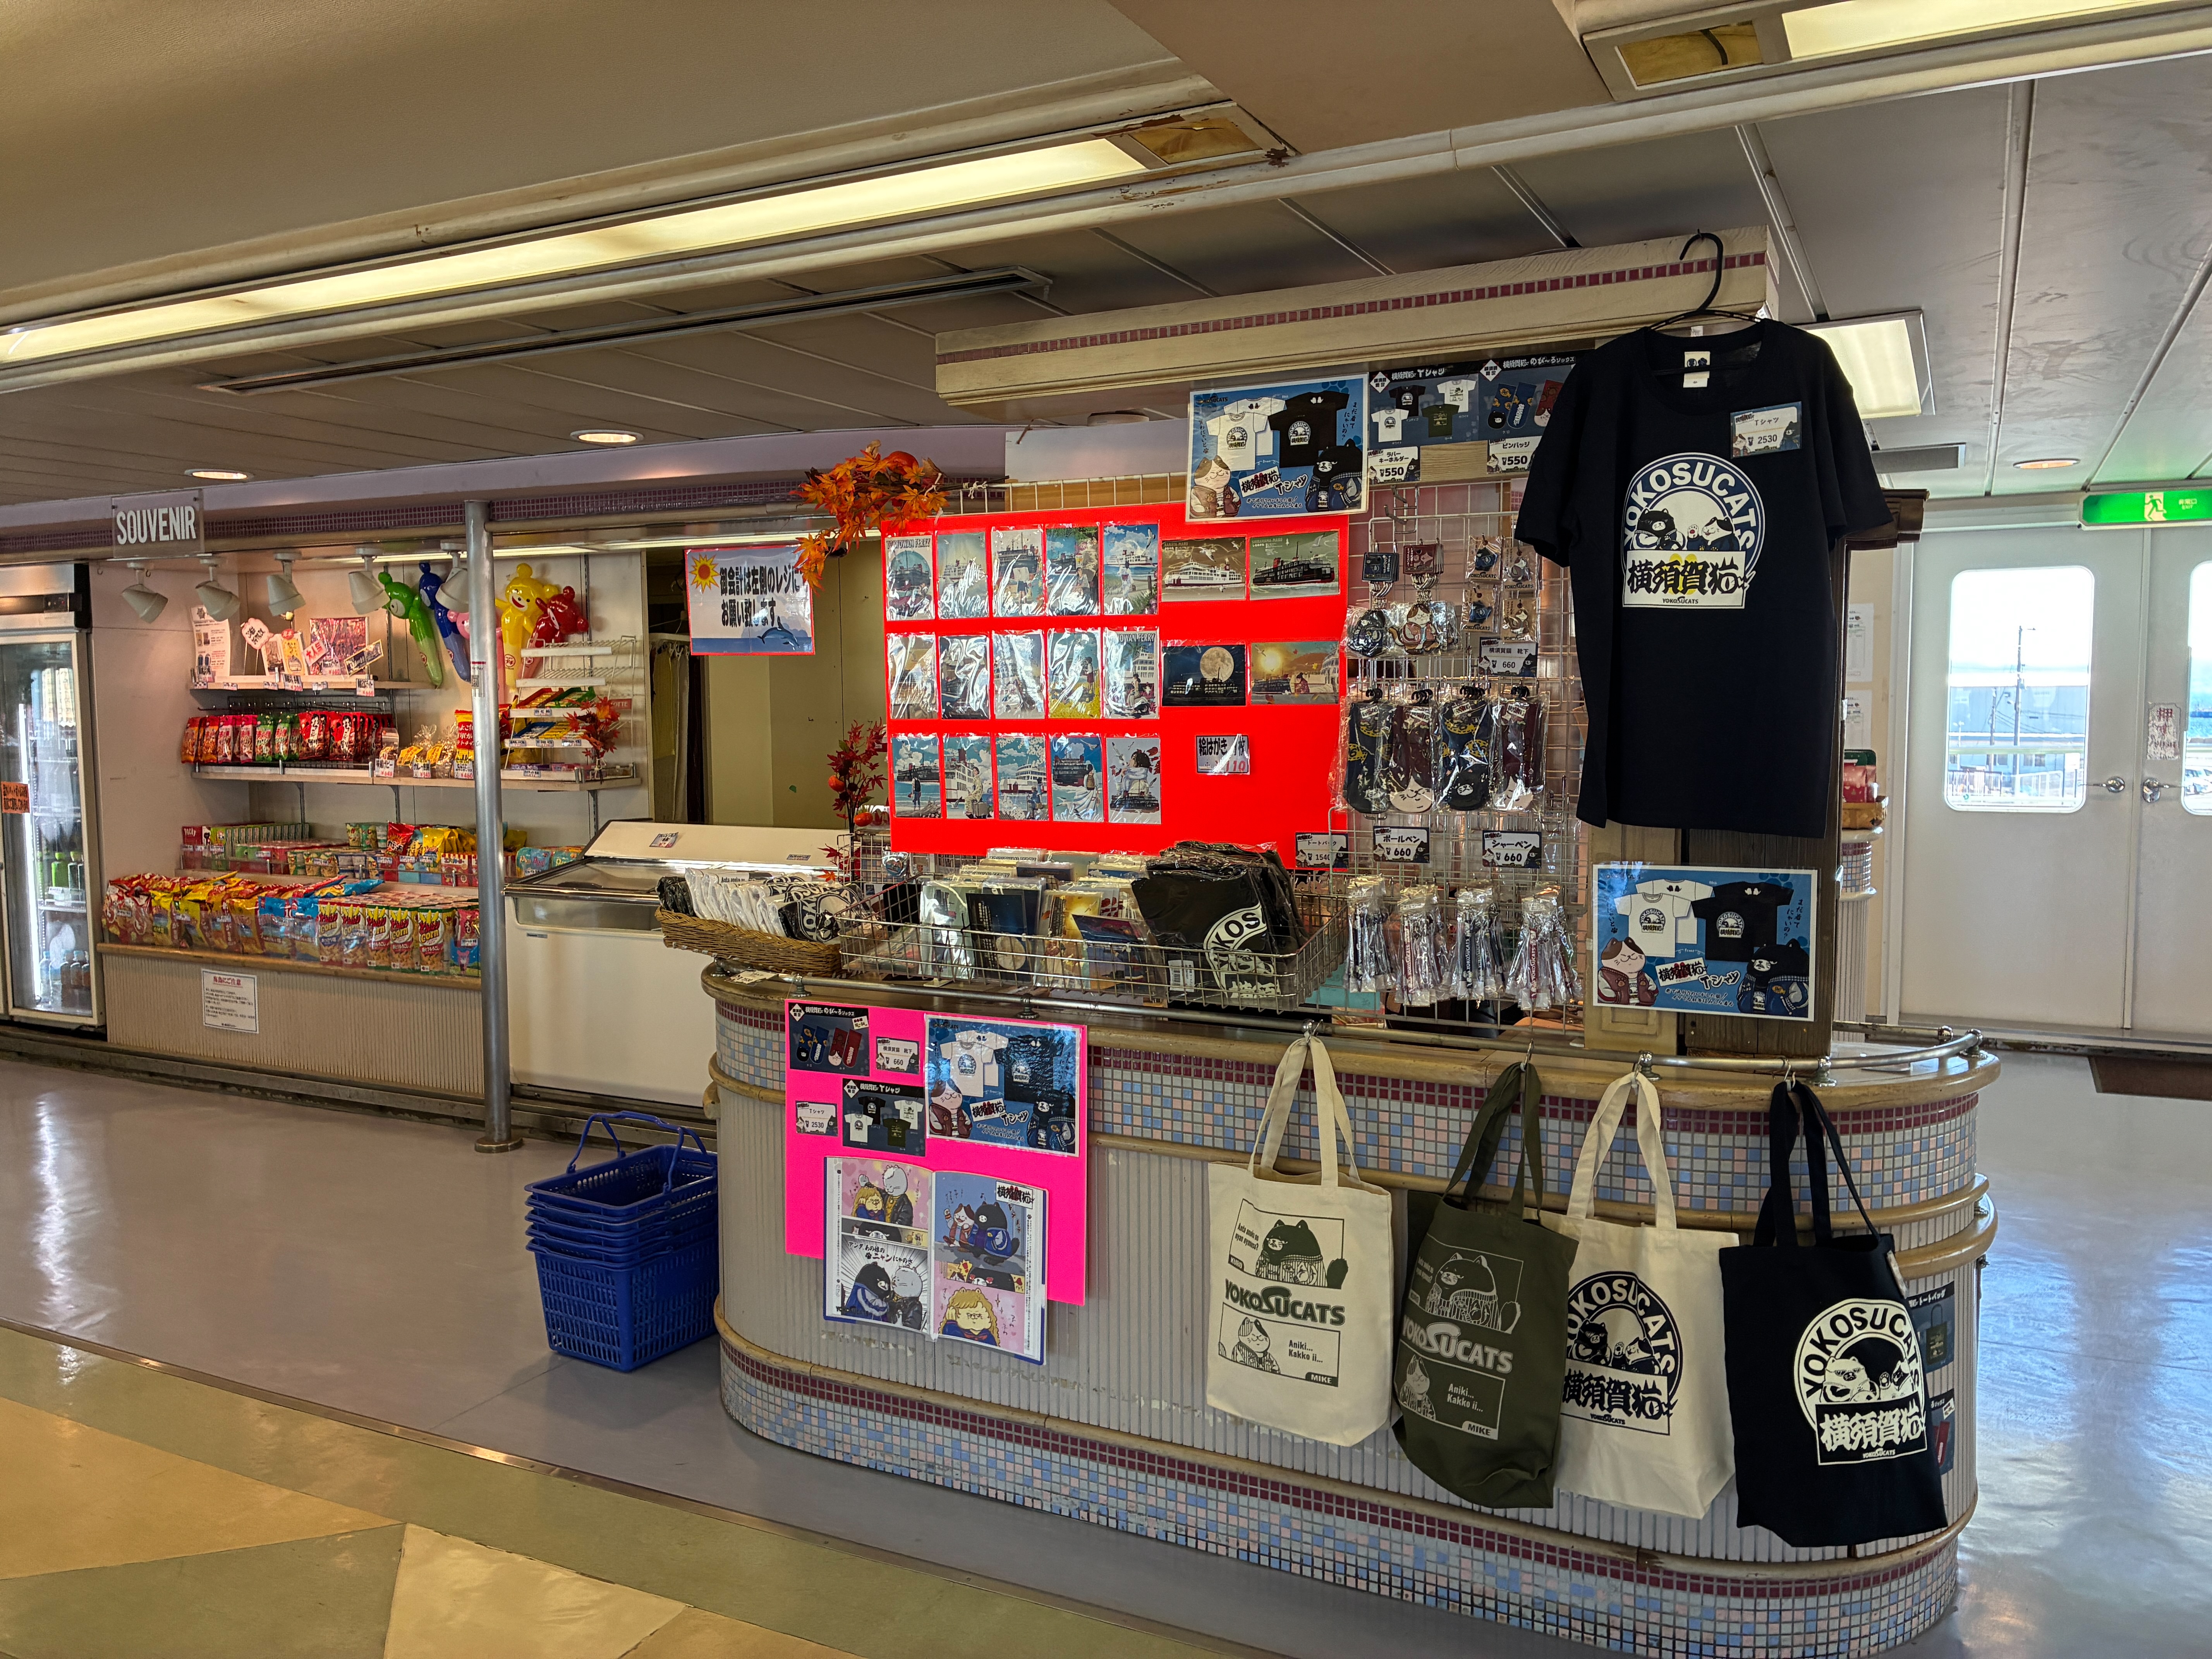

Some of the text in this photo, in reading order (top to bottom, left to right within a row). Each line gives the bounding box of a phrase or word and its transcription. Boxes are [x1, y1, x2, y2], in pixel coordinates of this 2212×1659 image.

[1758, 434, 1777, 444] 2530
[1625, 462, 1756, 548] YOKOSUCATS
[117, 506, 196, 545] SOUVENIR
[1662, 596, 1699, 604] YOKOSUCATS
[1137, 634, 1155, 642] FERRY
[1199, 737, 1227, 756] 絵はがき
[1492, 840, 1532, 849] シャーペン
[1394, 848, 1411, 857] 660
[1504, 853, 1522, 862] 660
[321, 922, 337, 934] Corn
[392, 927, 408, 940] Corn
[421, 929, 439, 943] Corn
[1230, 1257, 1242, 1269] KURO
[1225, 1279, 1345, 1326] YOKOSUCATS
[1567, 1279, 1675, 1373] OKOSUCATS
[1289, 1340, 1313, 1352] Aniki...
[1403, 1314, 1513, 1374] YOKOSUCATS
[1289, 1349, 1310, 1360] Kakko
[1311, 1374, 1332, 1384] MIKE
[1448, 1383, 1474, 1399] Aniki...
[1447, 1394, 1470, 1408] Kakko
[1590, 1413, 1625, 1425] YOKOSUCATS
[1468, 1423, 1491, 1436] MIKE
[1863, 1448, 1896, 1459] YOKOSUCATS
